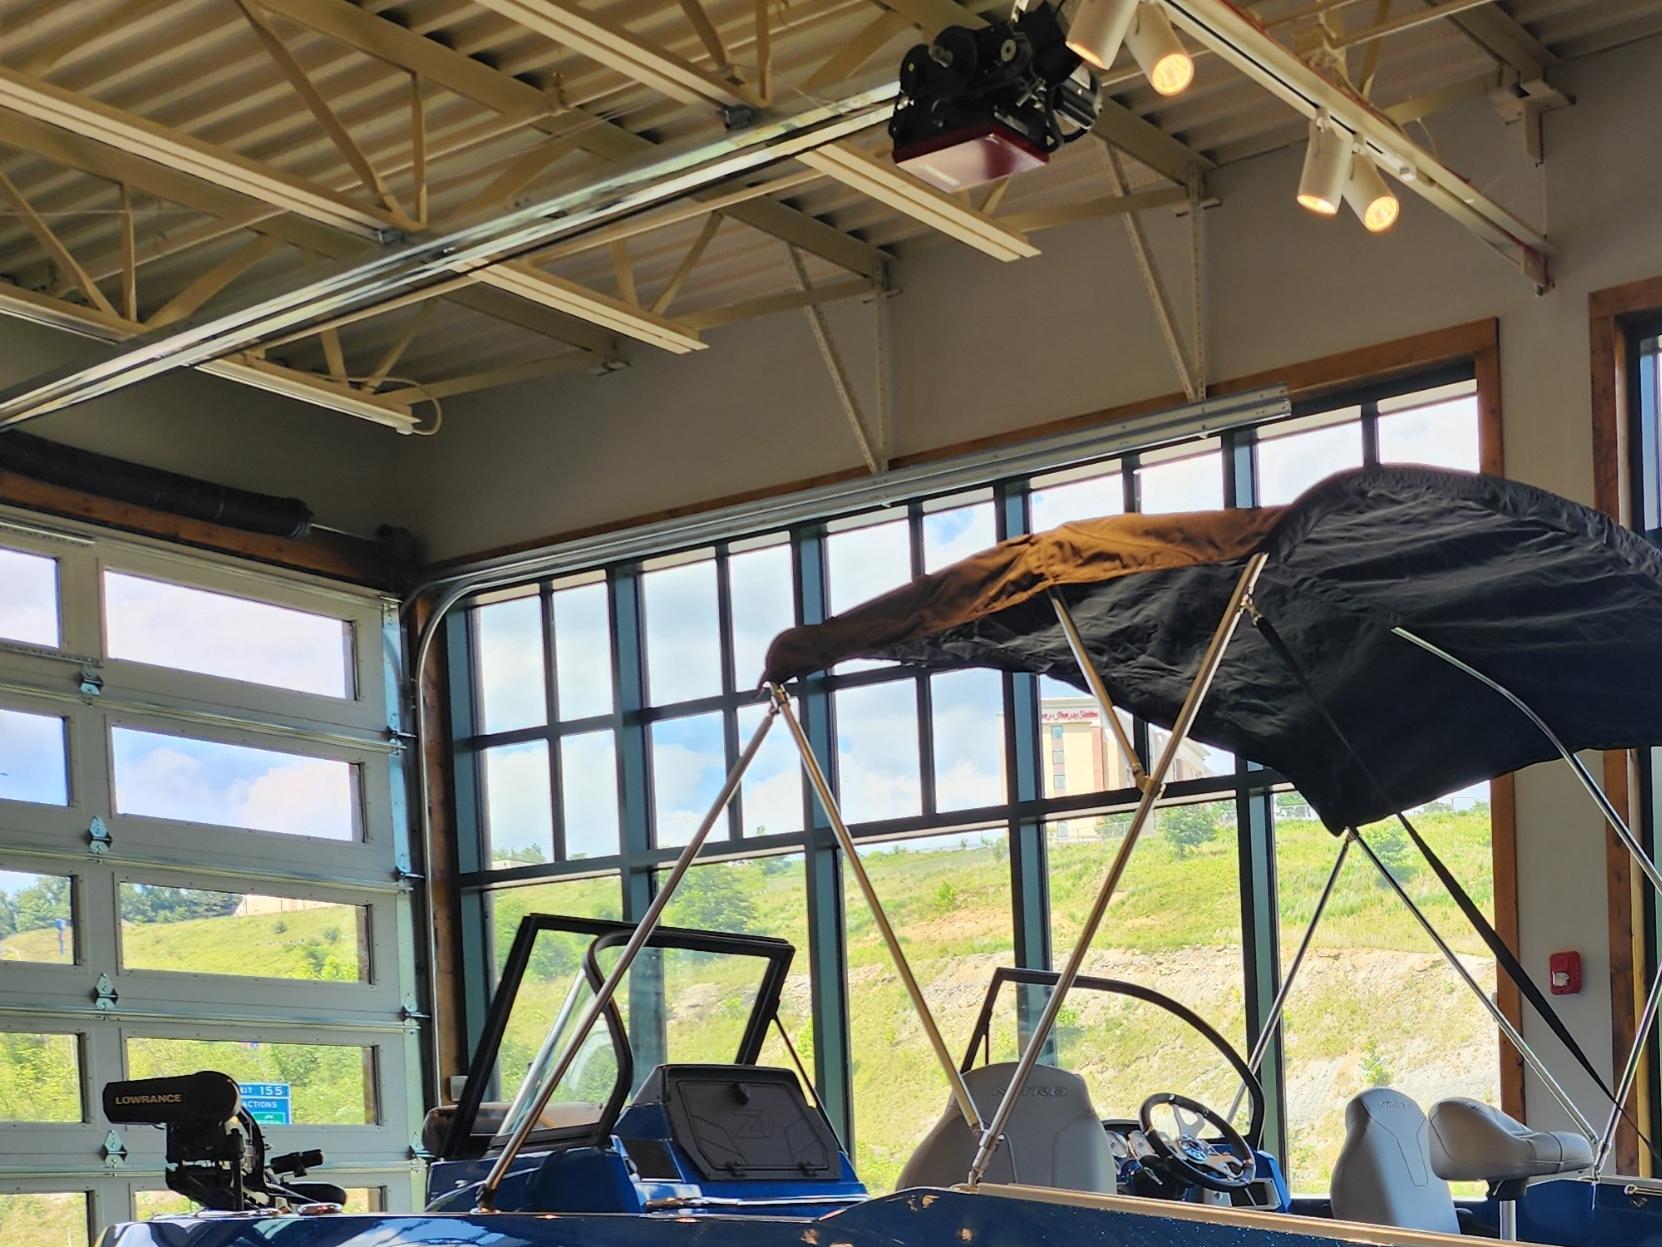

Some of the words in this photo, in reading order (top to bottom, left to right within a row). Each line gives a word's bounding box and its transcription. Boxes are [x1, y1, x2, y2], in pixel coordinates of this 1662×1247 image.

[260, 1086, 283, 1096] 155
[115, 1094, 182, 1105] LOWRANCE
[242, 1101, 278, 1109] ACTIONS
